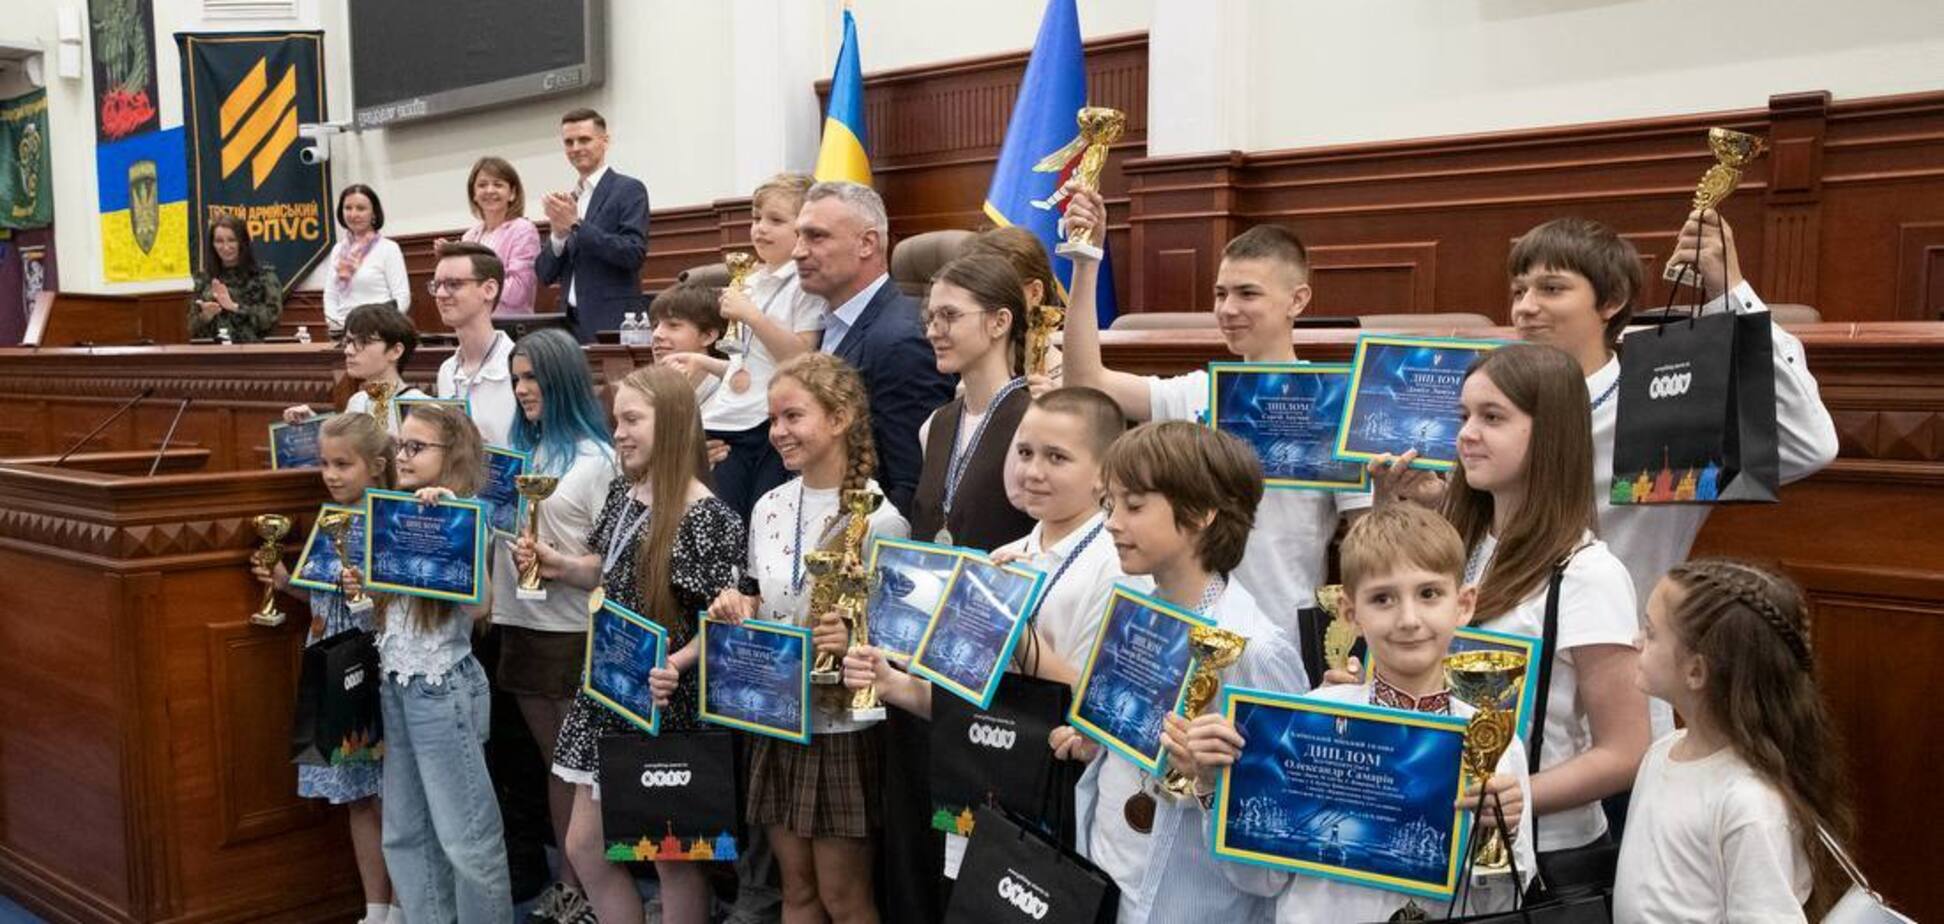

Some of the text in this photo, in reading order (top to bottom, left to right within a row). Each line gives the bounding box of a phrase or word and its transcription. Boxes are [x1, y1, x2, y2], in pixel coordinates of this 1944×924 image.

[968, 722, 1016, 750] KYIV
[1303, 743, 1381, 767] ДИПЛОМ
[641, 769, 692, 787] KYIV
[998, 876, 1049, 920] KYIV
